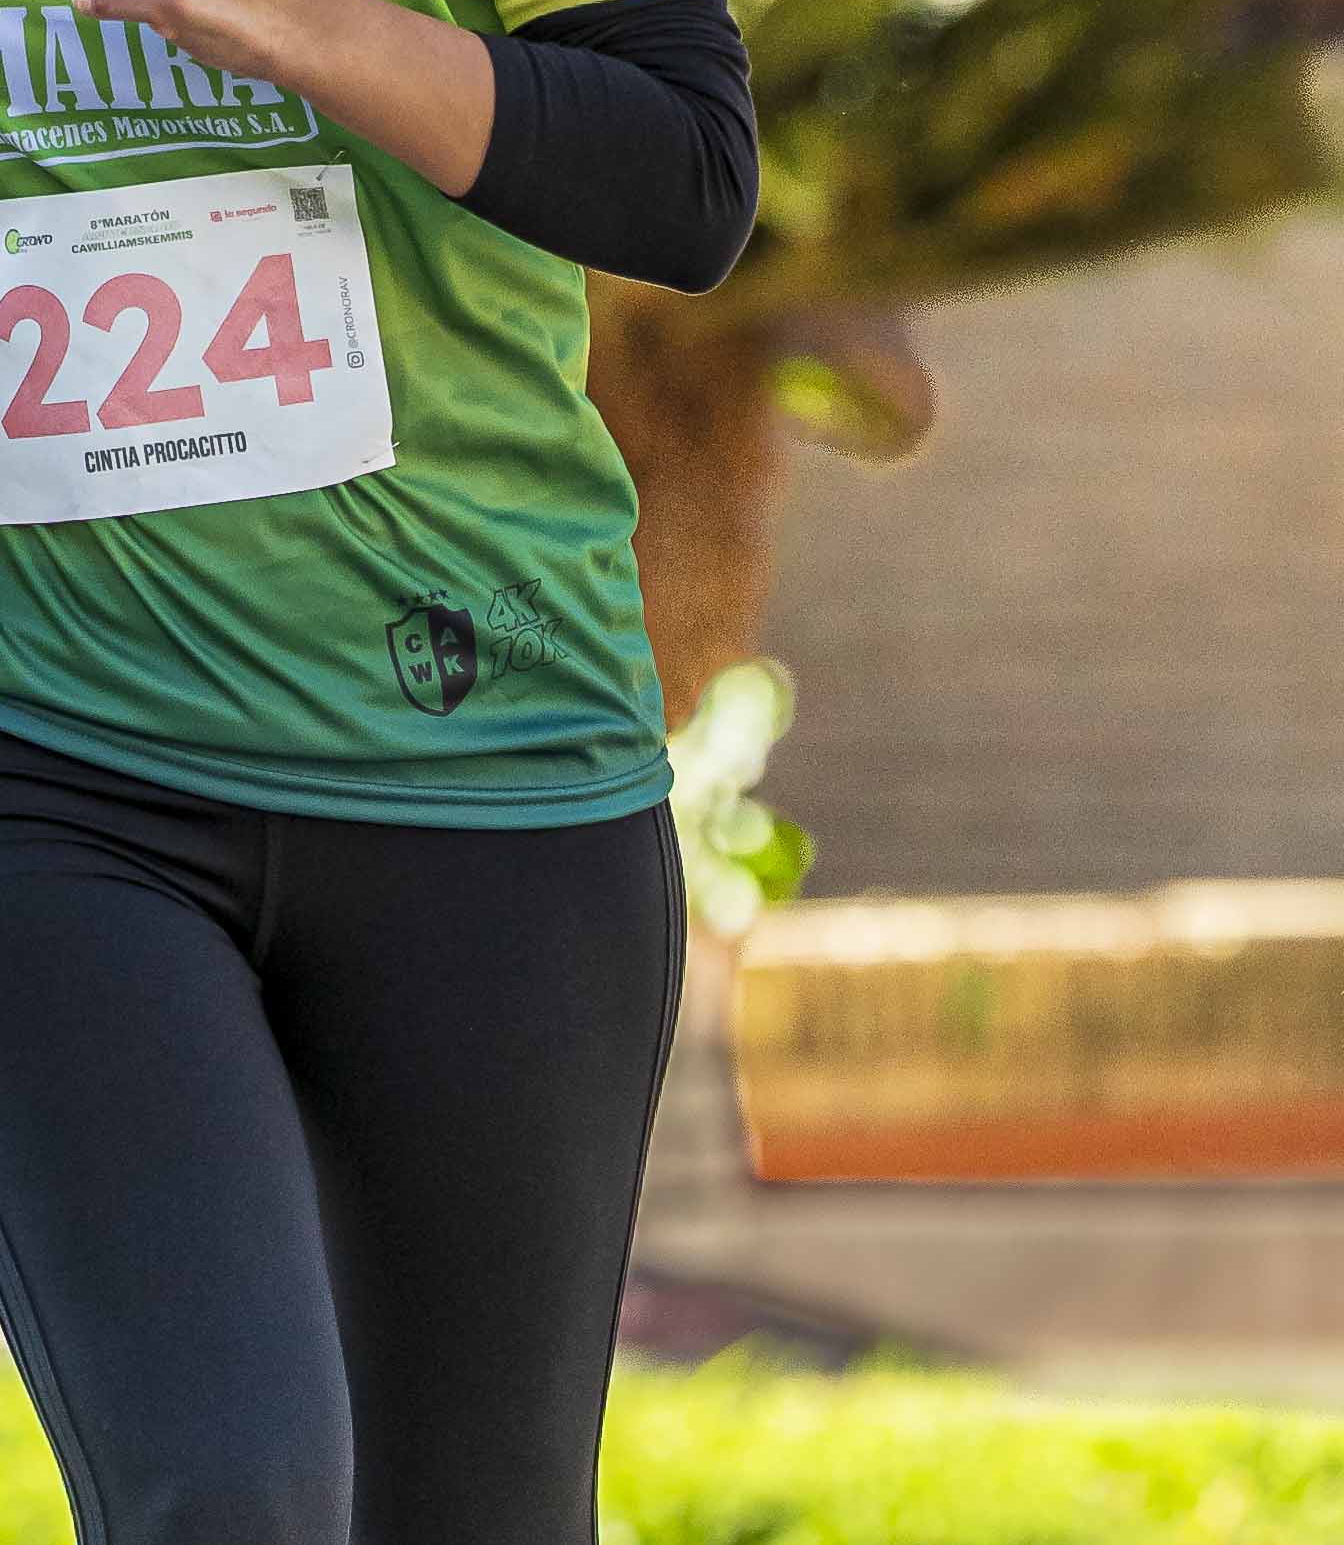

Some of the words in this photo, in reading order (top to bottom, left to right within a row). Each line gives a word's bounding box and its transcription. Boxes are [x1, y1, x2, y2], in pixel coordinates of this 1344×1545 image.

[112, 114, 242, 140] Mayoristas
[247, 111, 296, 136] S.A.
[71, 230, 194, 255] CAWILLIAMSKEMMIS
[84, 446, 141, 474] CINTIA
[143, 431, 248, 466] PROCACITTO
